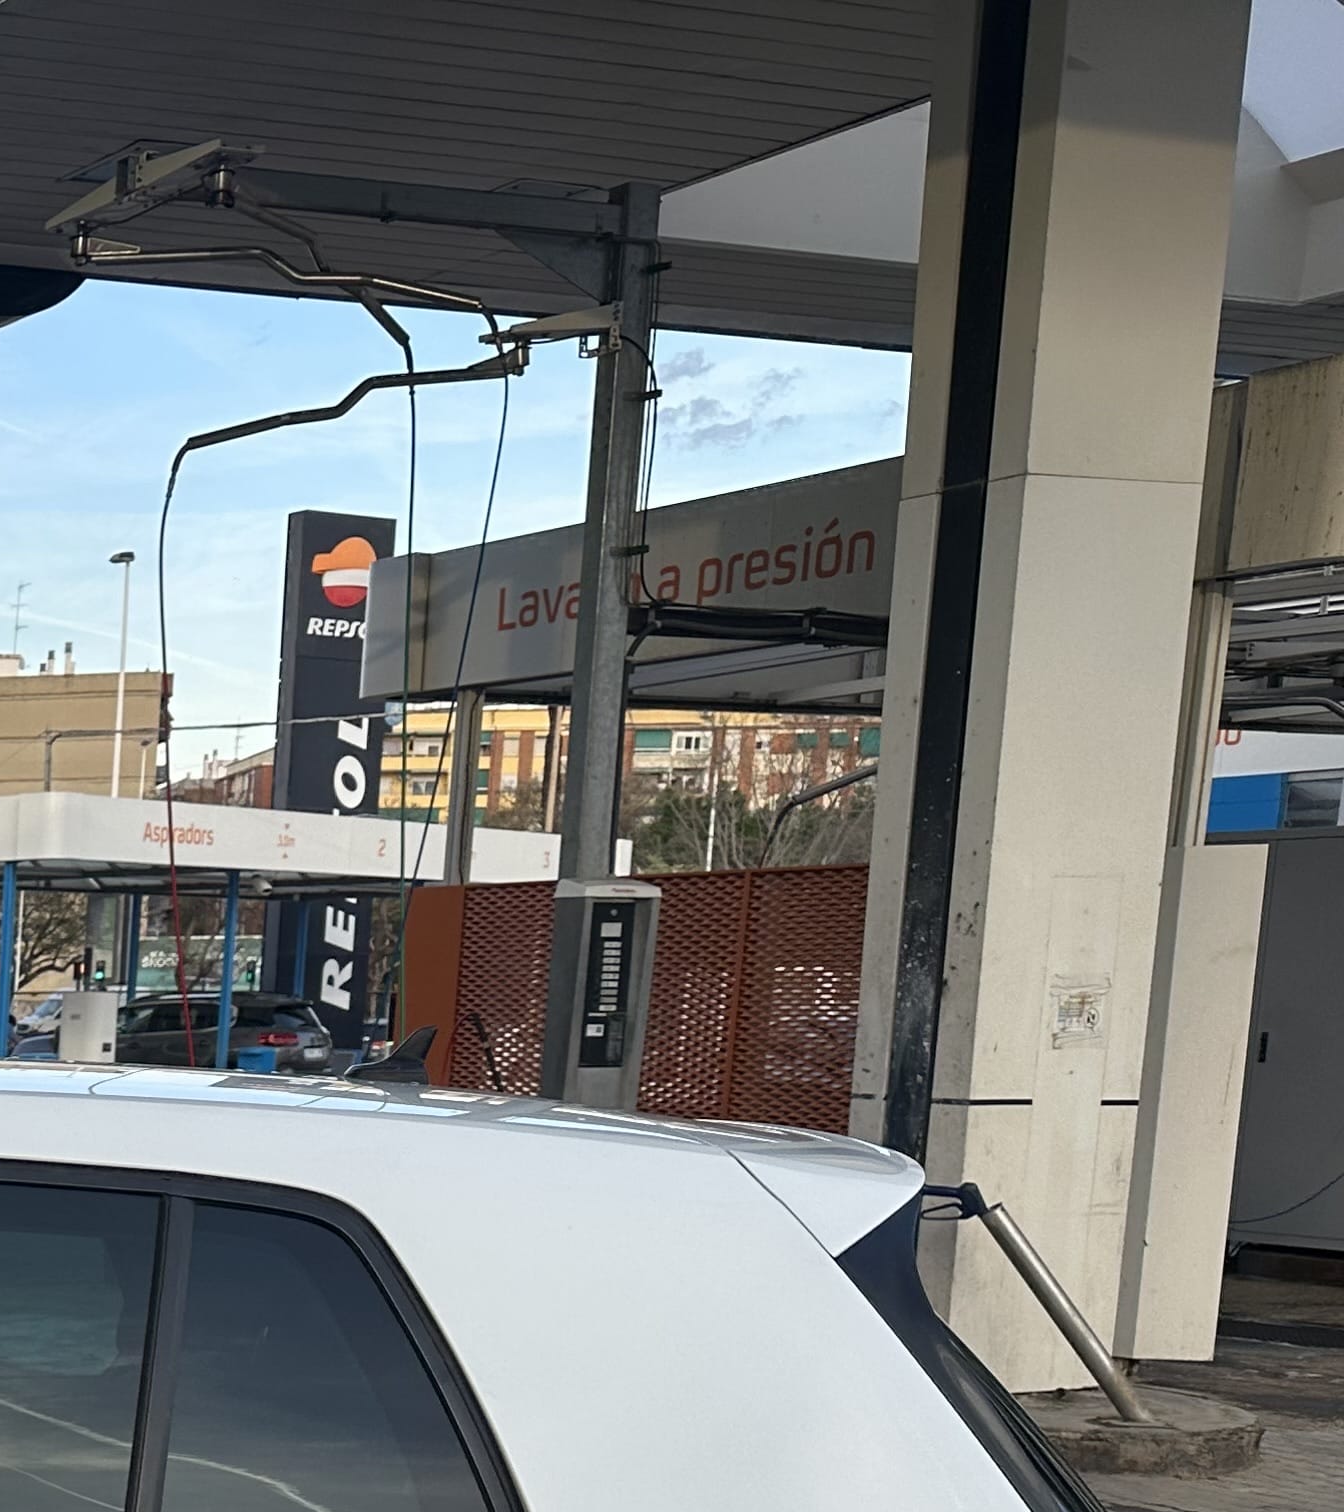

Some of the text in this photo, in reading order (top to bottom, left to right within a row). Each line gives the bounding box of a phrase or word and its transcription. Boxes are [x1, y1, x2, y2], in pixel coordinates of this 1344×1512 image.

[657, 565, 680, 602] a
[696, 517, 875, 606] presión
[143, 822, 214, 848] Aspradors
[377, 839, 386, 857] 2
[320, 717, 369, 1011] REOL
